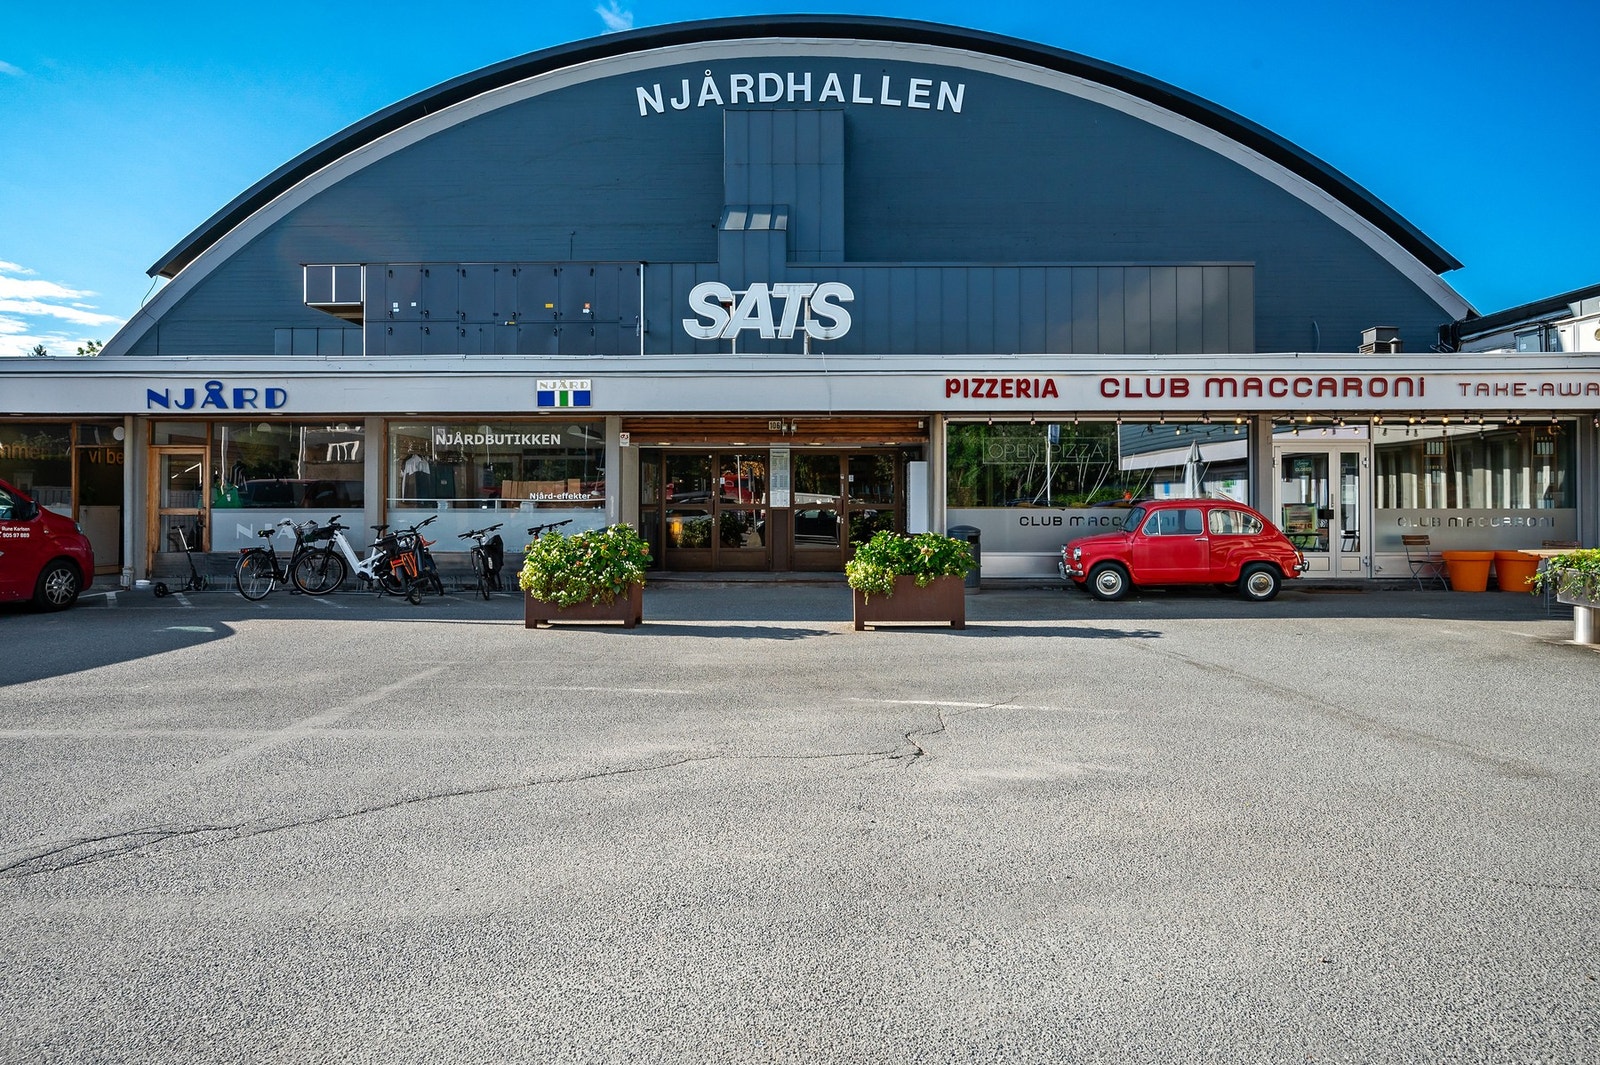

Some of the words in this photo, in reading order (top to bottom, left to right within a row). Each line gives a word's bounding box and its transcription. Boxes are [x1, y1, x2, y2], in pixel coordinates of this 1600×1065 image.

[636, 69, 966, 116] NJÅRDHALLEN
[682, 281, 855, 340] SATS
[539, 379, 589, 389] NJÅRD
[945, 378, 1059, 398] PIZZERIA
[1100, 377, 1190, 398] CLUB
[146, 380, 288, 410] NJÅRD
[769, 421, 781, 430] 106
[435, 431, 561, 446] NJÅRDBUTIKKEN
[988, 443, 1039, 459] OPEN
[1050, 443, 1105, 459] PIZZA
[529, 492, 592, 500] Njård-effekter
[1019, 516, 1063, 527] CLUB
[1397, 516, 1441, 527] CLUB
